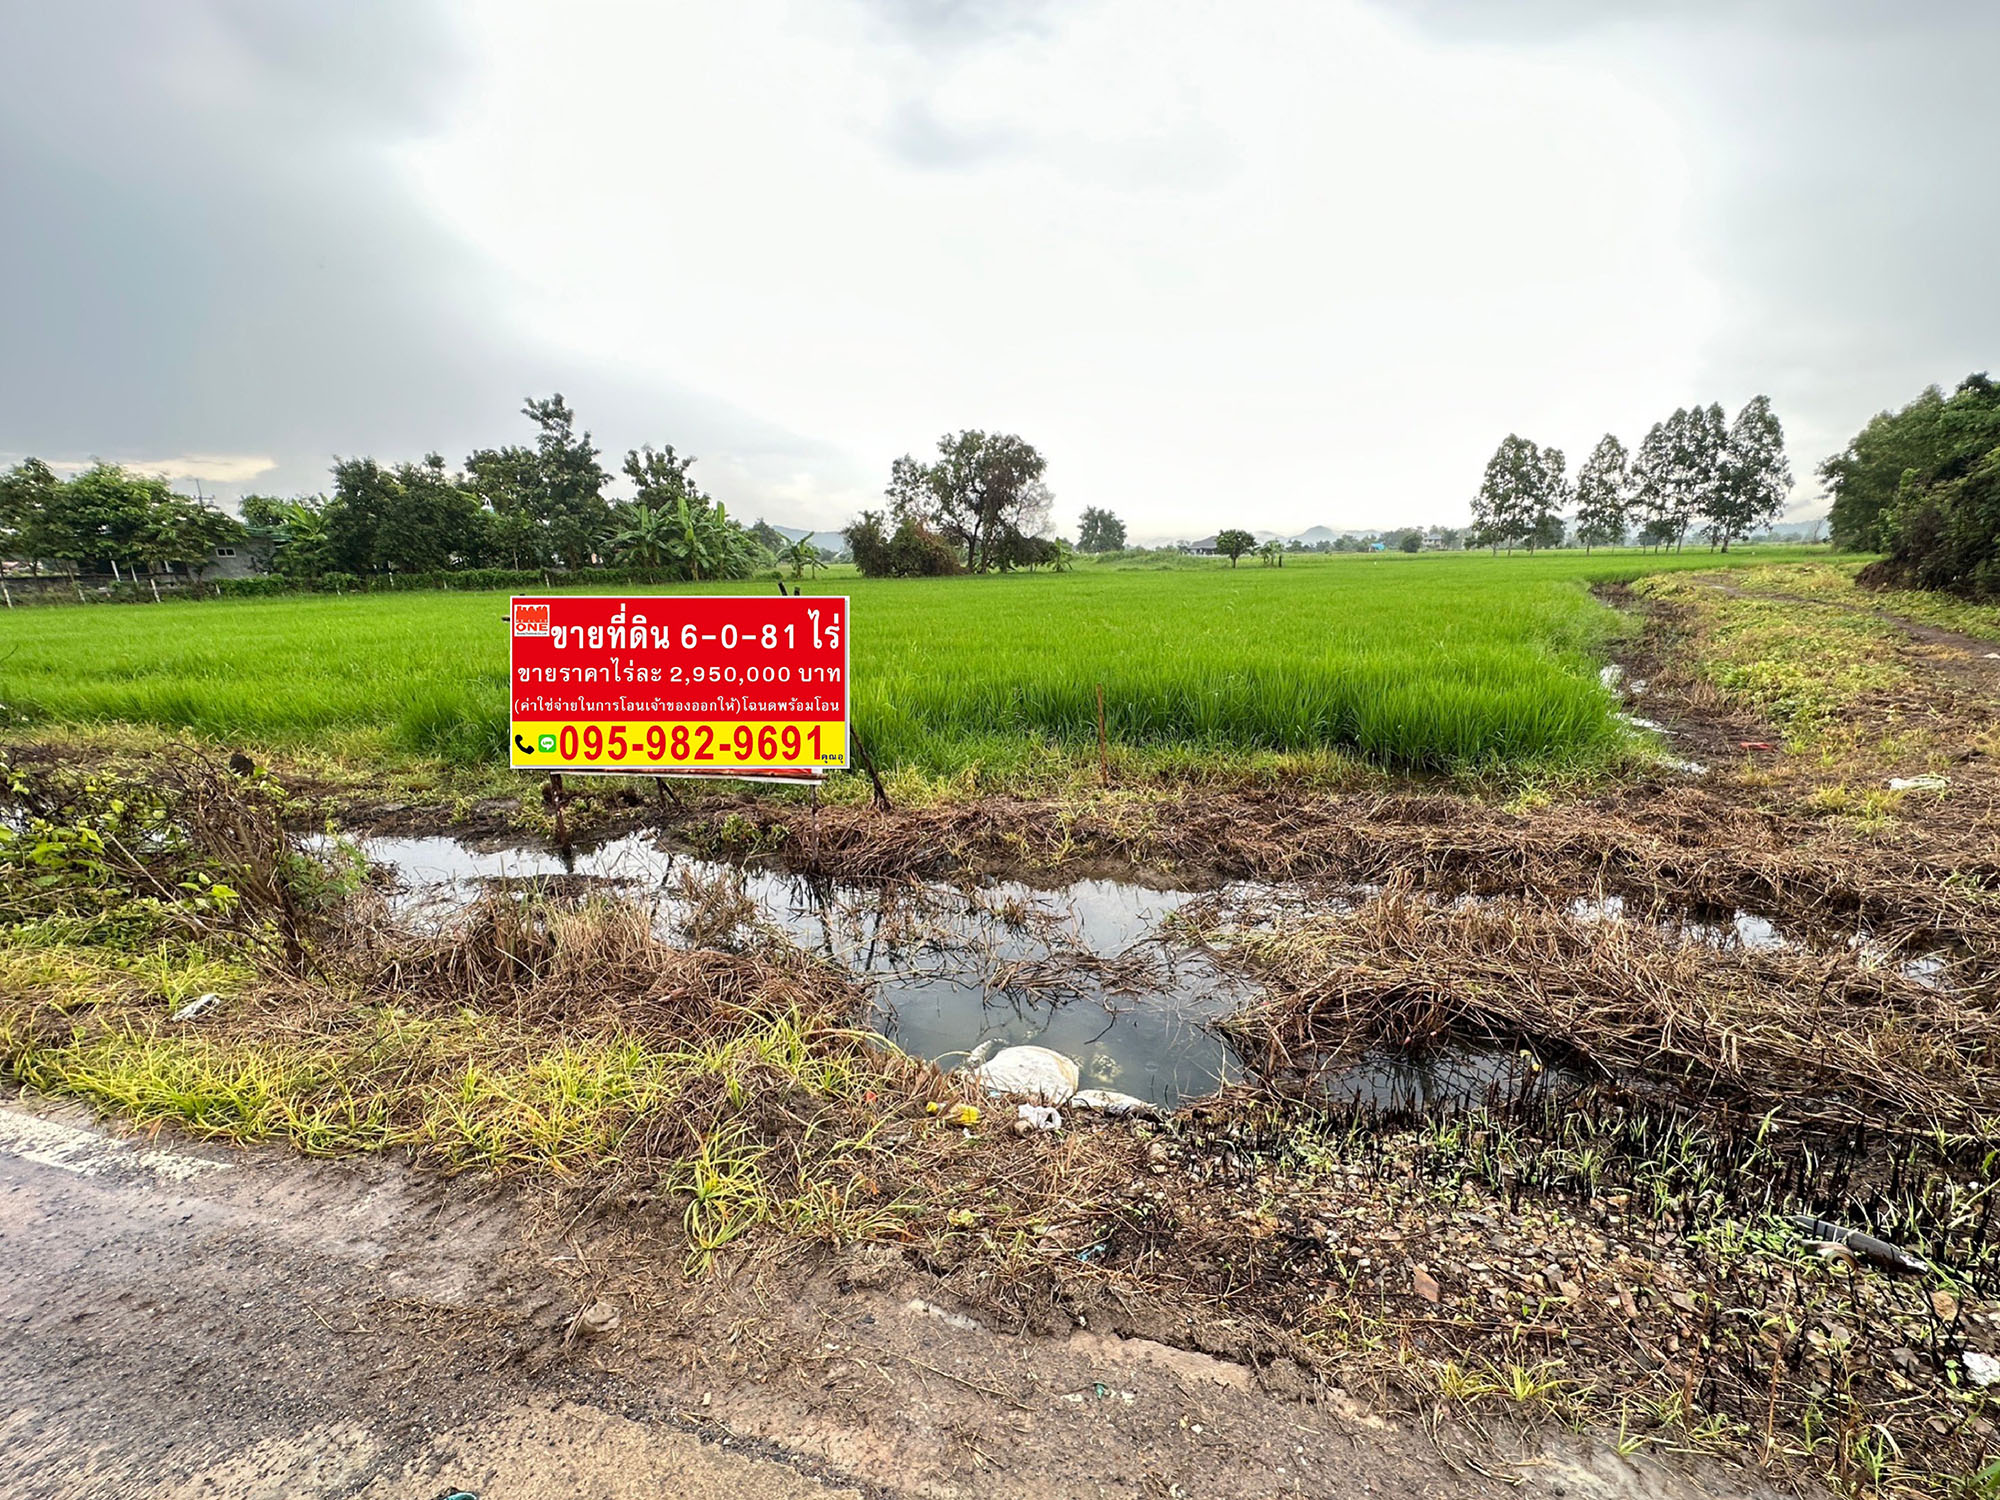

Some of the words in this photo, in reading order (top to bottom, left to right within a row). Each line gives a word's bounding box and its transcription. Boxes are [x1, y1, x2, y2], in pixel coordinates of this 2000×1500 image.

[515, 623, 548, 632] ONE
[551, 603, 670, 650] ขายที่ดิน
[681, 624, 795, 650] 6-0-81
[808, 609, 841, 650] ไร่
[517, 657, 662, 683] ขายราคาไร่ละ
[669, 667, 791, 686] 2,950,000
[798, 667, 841, 683] บาท
[560, 725, 821, 761] 095-982-9691
